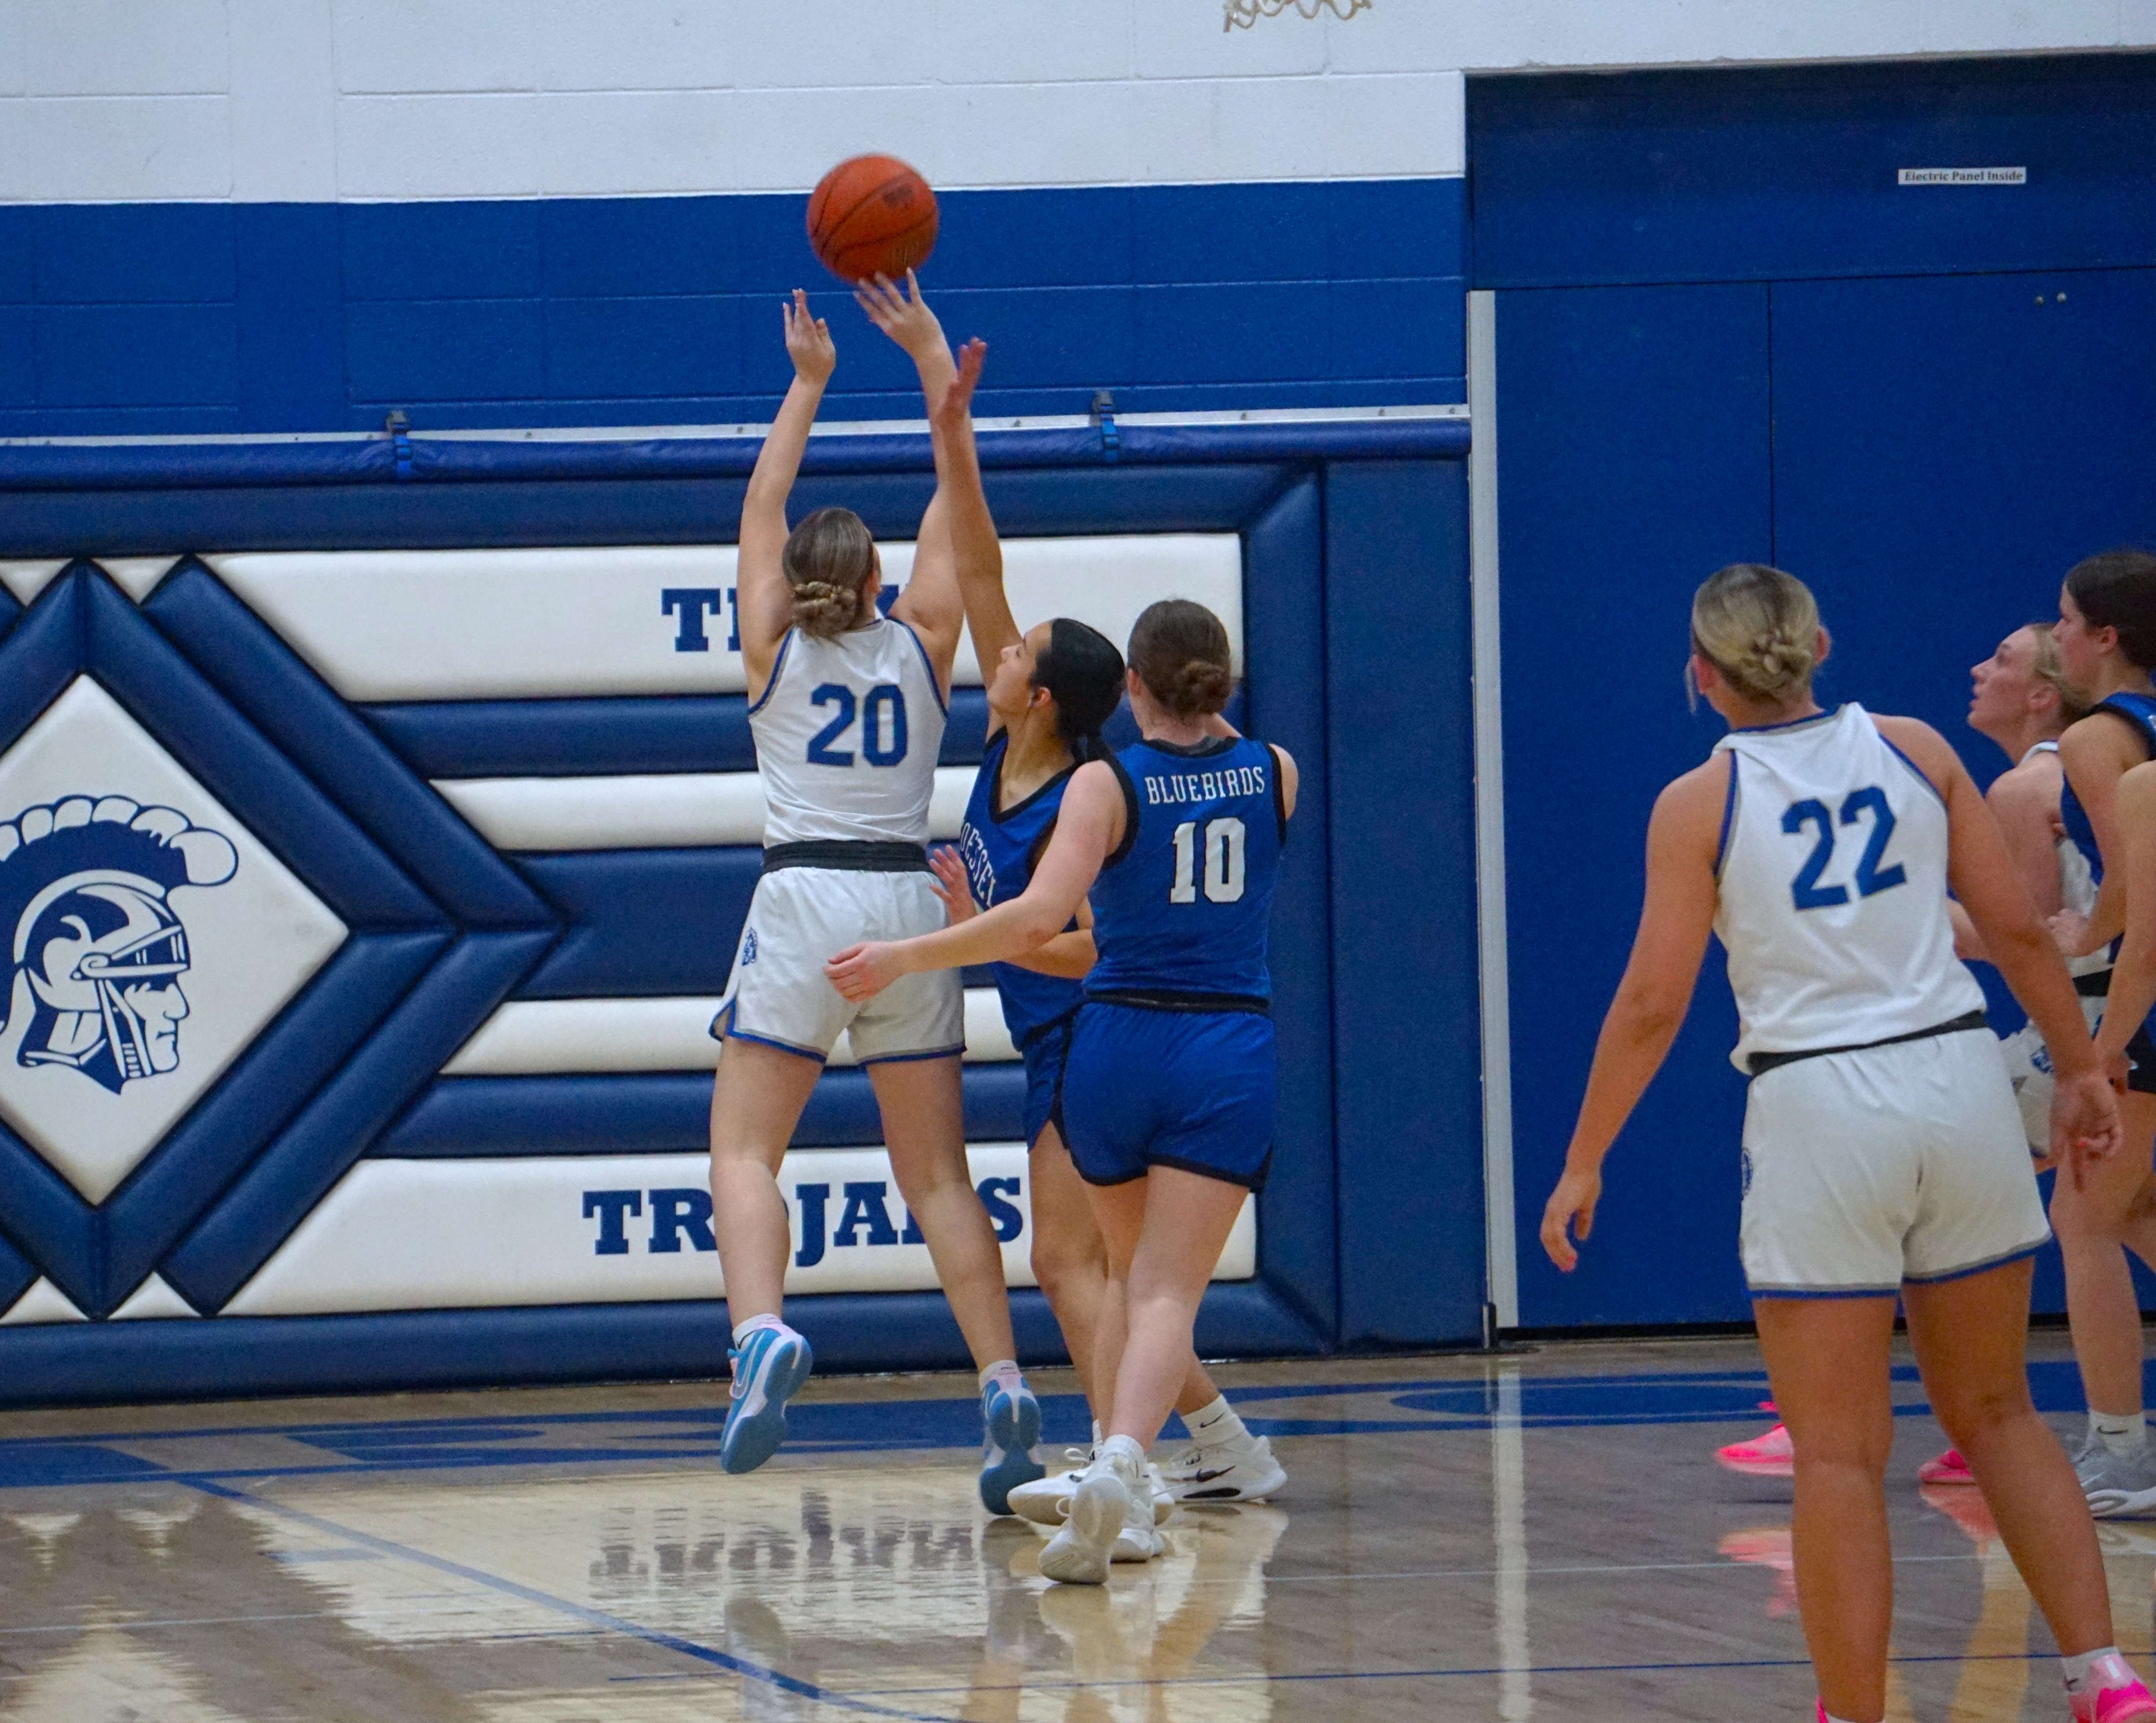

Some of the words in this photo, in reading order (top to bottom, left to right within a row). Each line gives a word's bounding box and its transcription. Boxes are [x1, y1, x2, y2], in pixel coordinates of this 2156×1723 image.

[1905, 171, 1949, 180] Electric
[1952, 171, 1984, 180] Panel
[1988, 170, 2023, 180] Inside
[806, 683, 907, 767] 20
[1145, 766, 1265, 805] BLUEBIRDS
[960, 822, 996, 908] OESSEL
[1169, 817, 1246, 903] 10
[1781, 785, 1907, 911] 22
[582, 1177, 1023, 1267] TRJAS
